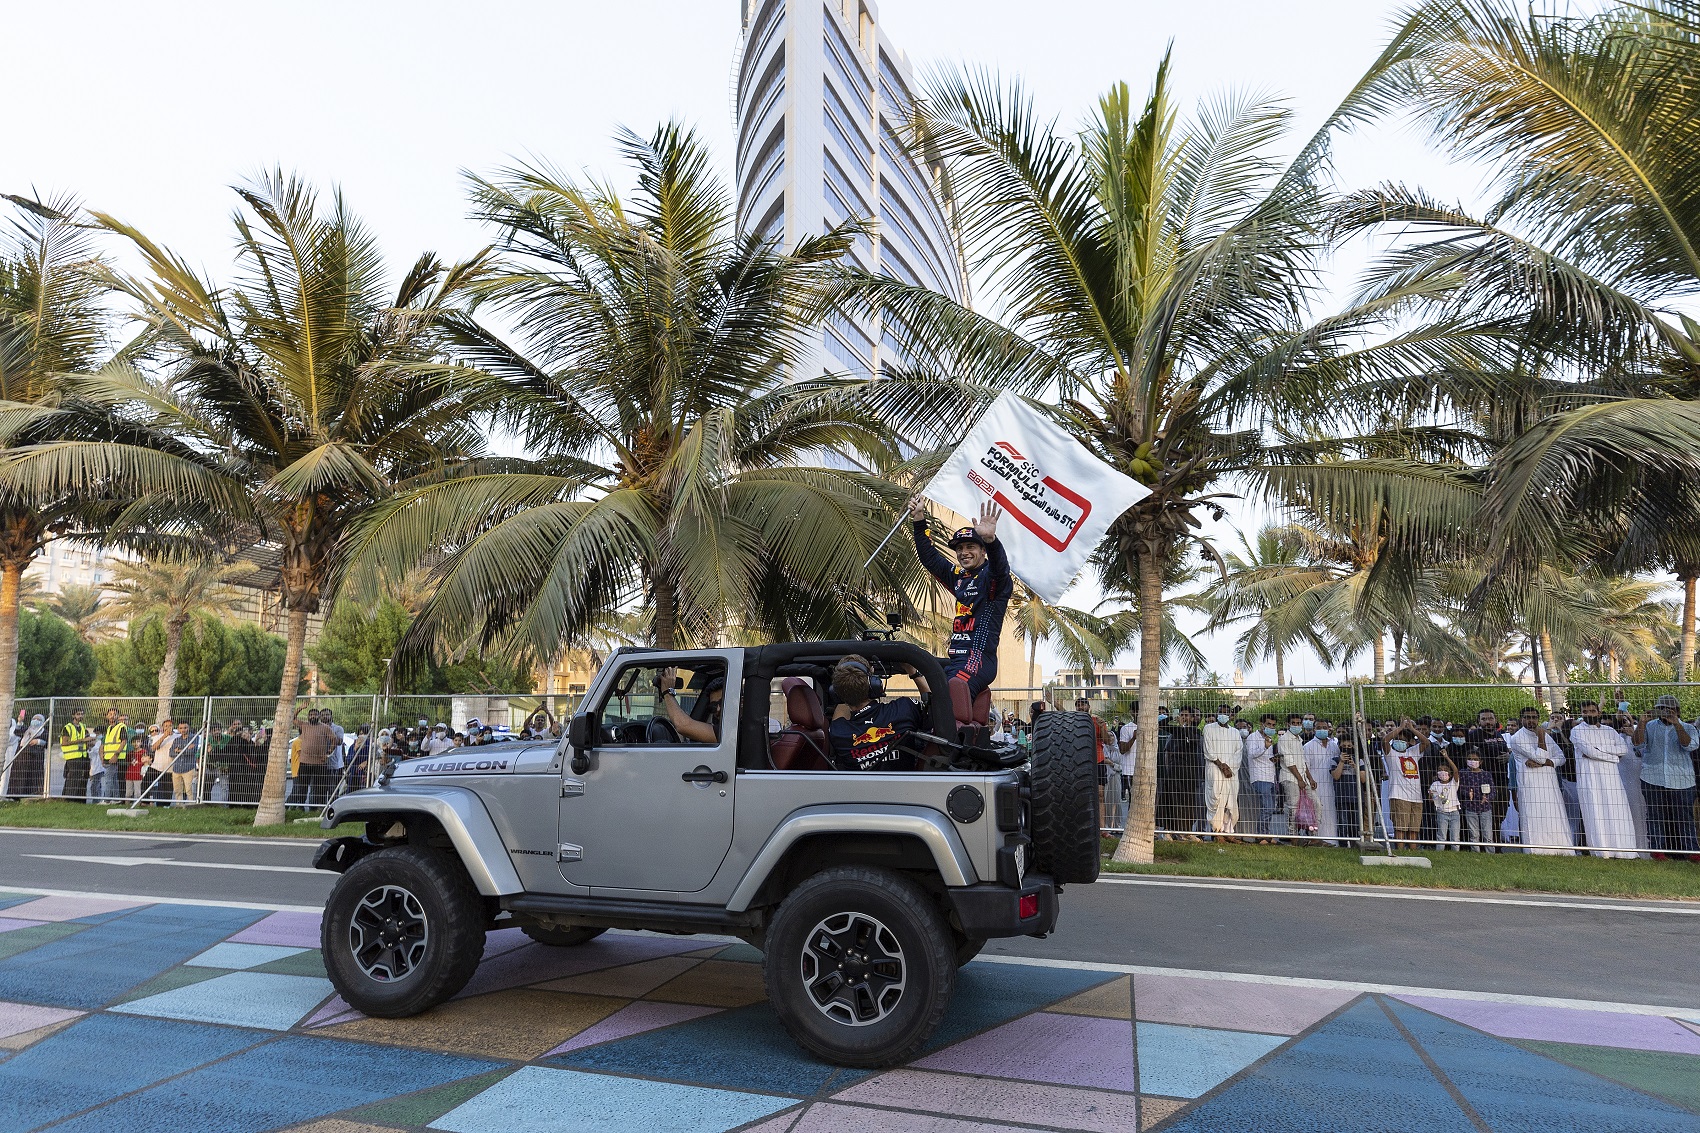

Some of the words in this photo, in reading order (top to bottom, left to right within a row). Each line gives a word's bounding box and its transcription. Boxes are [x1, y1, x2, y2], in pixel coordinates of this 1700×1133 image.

[986, 447, 1040, 493] FORMULA
[966, 469, 995, 497] 2021
[1059, 515, 1077, 529] STC
[953, 617, 976, 632] Bull
[414, 760, 508, 773] RUBICON
[510, 849, 553, 857] WRANGLER
